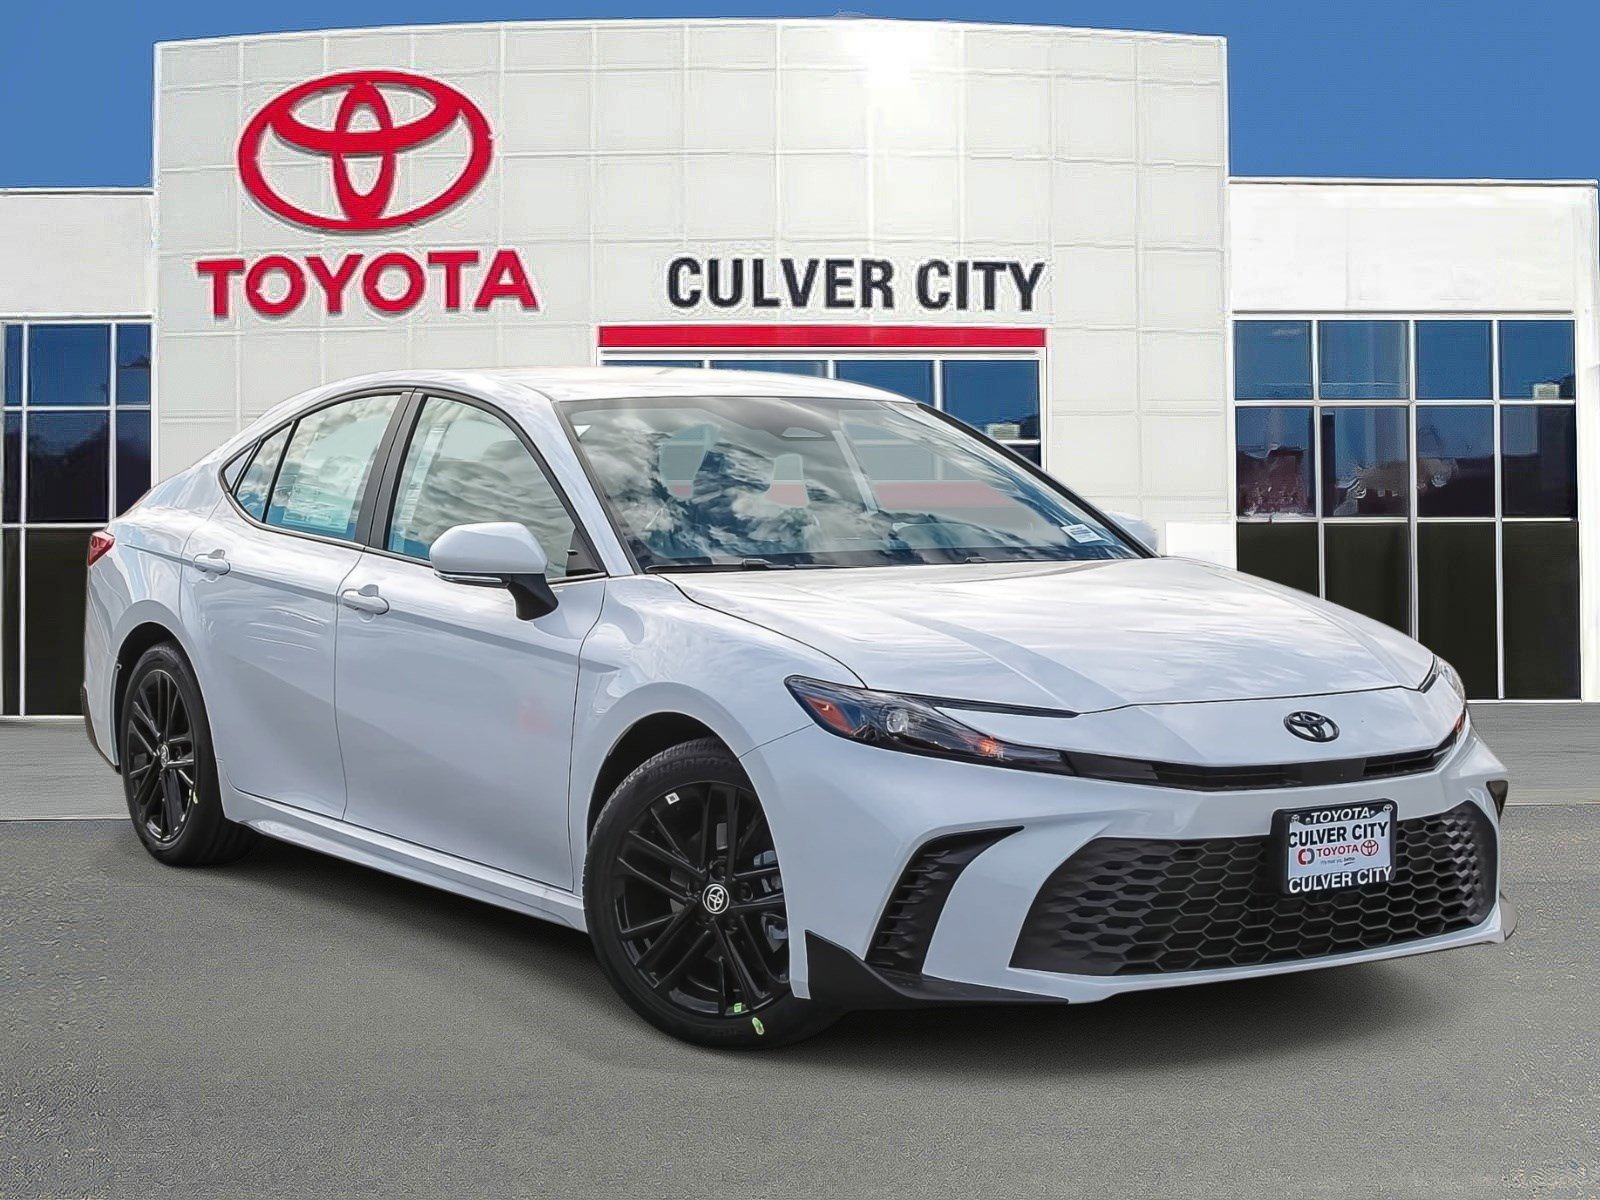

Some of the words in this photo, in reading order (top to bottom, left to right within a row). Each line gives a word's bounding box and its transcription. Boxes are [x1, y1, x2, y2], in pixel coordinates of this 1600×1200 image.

[196, 249, 540, 318] TOYOTA
[667, 257, 895, 308] CULVER
[915, 259, 1045, 311] CITY
[1311, 807, 1371, 824] TOYOTA
[1289, 827, 1348, 848] CULVER
[1352, 821, 1388, 840] CITY
[1317, 844, 1360, 858] TOYOTA
[1289, 871, 1353, 893] CULVER
[1357, 866, 1392, 885] CITY
